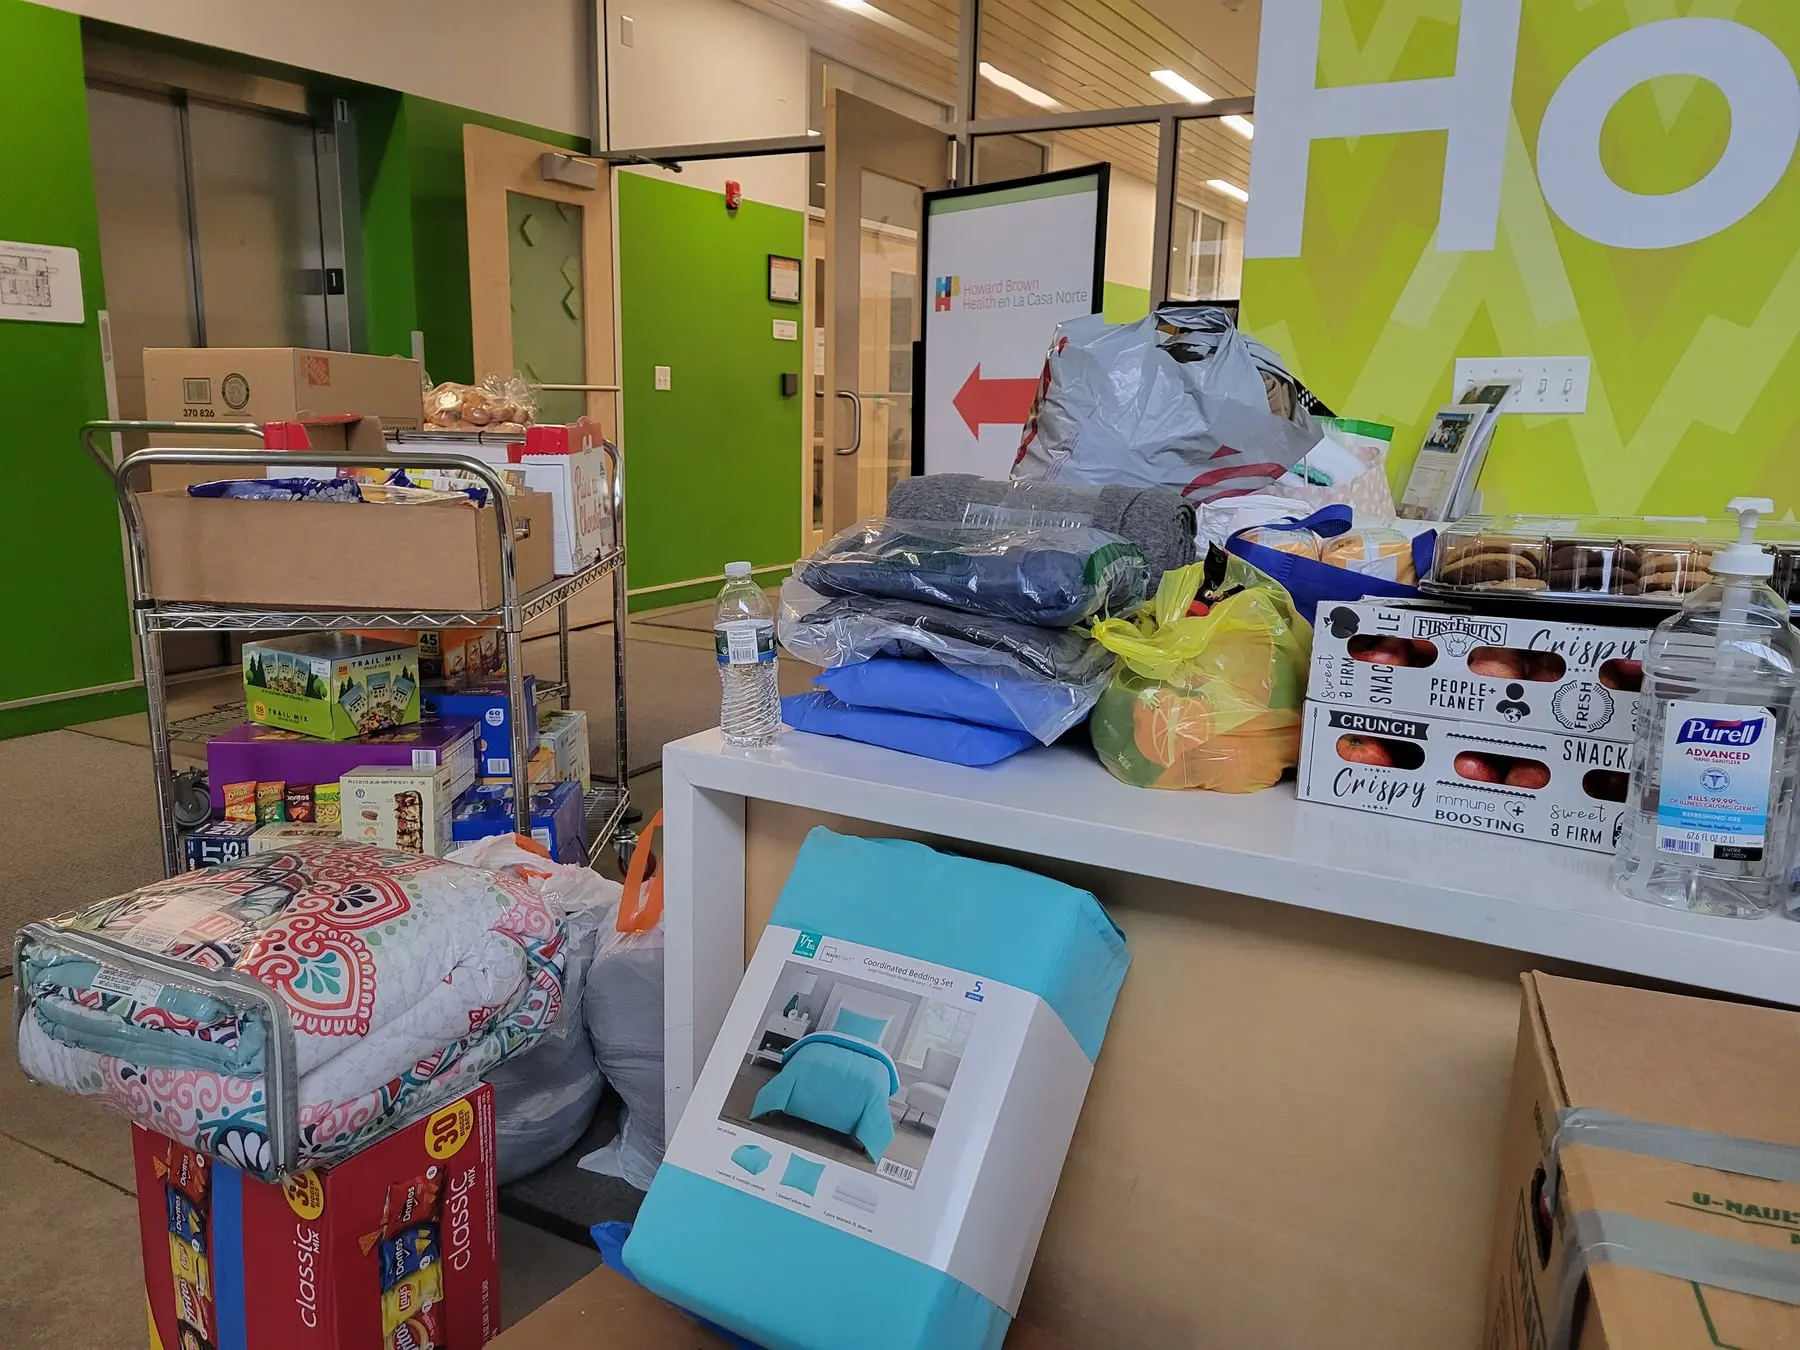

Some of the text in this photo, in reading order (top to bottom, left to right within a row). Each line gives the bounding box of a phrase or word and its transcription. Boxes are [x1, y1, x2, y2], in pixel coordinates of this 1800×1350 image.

[963, 278, 1040, 296] Howard Brown
[963, 289, 1088, 311] Health en La Casa Norte
[183, 408, 215, 418] 370 826
[420, 633, 438, 646] 45
[1527, 628, 1637, 669] Crispy
[351, 653, 402, 668] TRAIL MIX
[1340, 657, 1355, 686] FIRM
[1317, 653, 1336, 699] Sweet
[1429, 692, 1485, 712] PLANET
[1574, 682, 1593, 729] FRESH
[268, 707, 290, 718] TRAIL
[293, 714, 309, 722] MIX
[1339, 713, 1417, 737] CRUNCH
[1687, 719, 1756, 744] Purell
[1685, 747, 1751, 761] ADVANCED
[1332, 766, 1427, 809] Crispy
[1687, 795, 1708, 803] KILLS
[1435, 791, 1496, 813] immune
[1550, 804, 1607, 823] Sweet
[1704, 802, 1733, 811] CAUSING
[1434, 809, 1525, 835] BOOSTING
[1681, 811, 1727, 821] REFRESHING
[1566, 825, 1603, 845] FIRM
[1686, 831, 1700, 841] 67.6
[1710, 834, 1719, 843] OZ
[863, 956, 908, 975] Coordinated
[908, 969, 940, 985] Bedding
[941, 977, 954, 988] Set
[972, 980, 984, 993] 5
[432, 1112, 459, 1153] 30
[180, 1154, 189, 1187] Doritos
[467, 1165, 476, 1189] MIX
[402, 1185, 415, 1222] Doritos
[445, 1170, 471, 1271] classic
[311, 1230, 321, 1254] MIX
[395, 1238, 405, 1276] Doritos
[293, 1223, 318, 1328] classic
[394, 1323, 420, 1350] ritos
